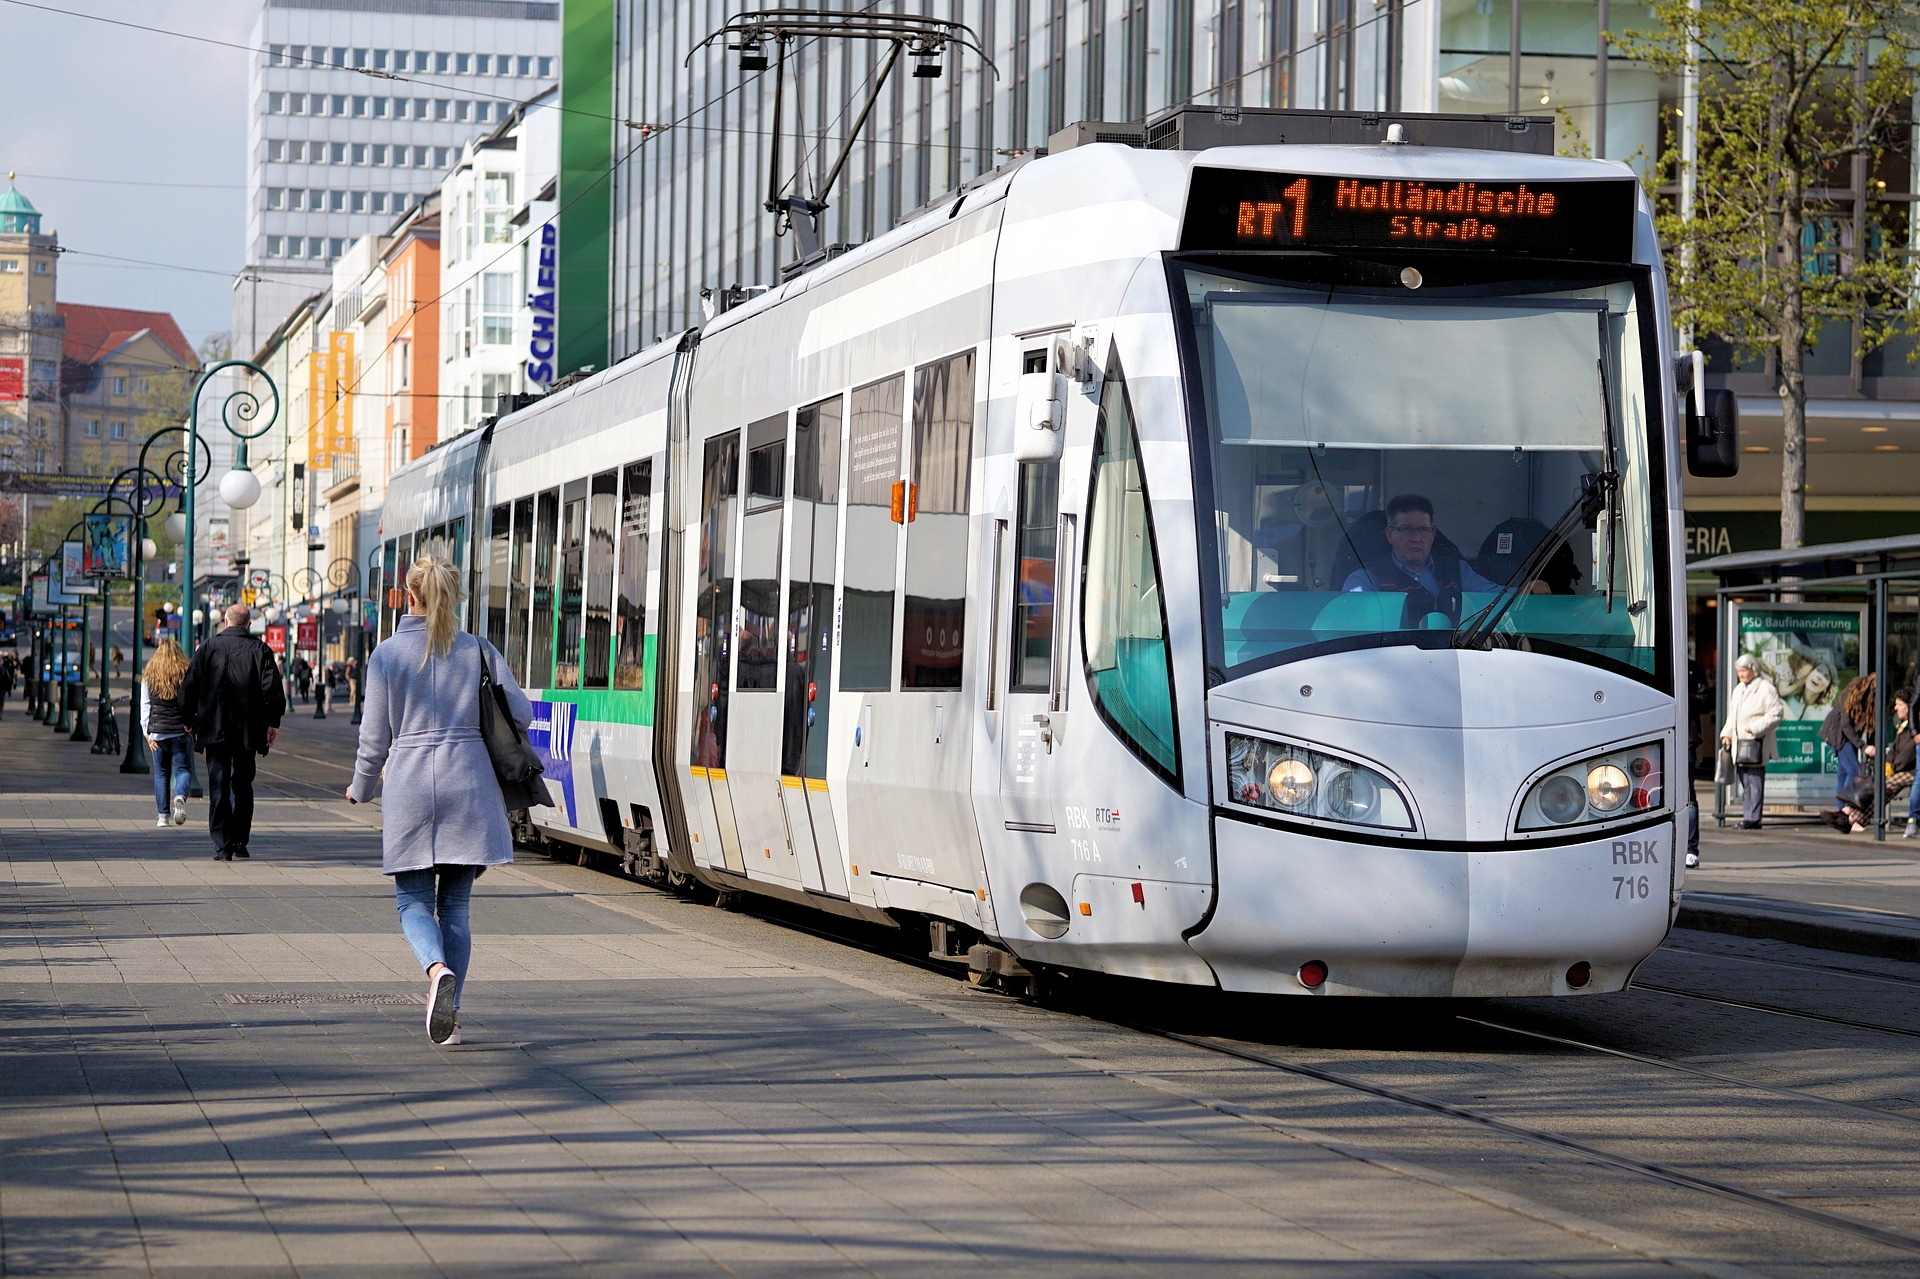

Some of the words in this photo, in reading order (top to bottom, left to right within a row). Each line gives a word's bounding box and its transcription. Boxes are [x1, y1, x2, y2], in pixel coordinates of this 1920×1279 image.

[1336, 179, 1557, 217] Holländische
[1390, 216, 1497, 240] Straße
[1742, 617, 1762, 628] PSD
[1765, 616, 1851, 631] Baufinanzierung
[1066, 806, 1091, 830] RBK
[1095, 808, 1111, 824] RTG
[1070, 839, 1091, 863] 716
[1092, 840, 1101, 863] A
[1612, 841, 1658, 864] RBK
[1613, 875, 1649, 899] 716
